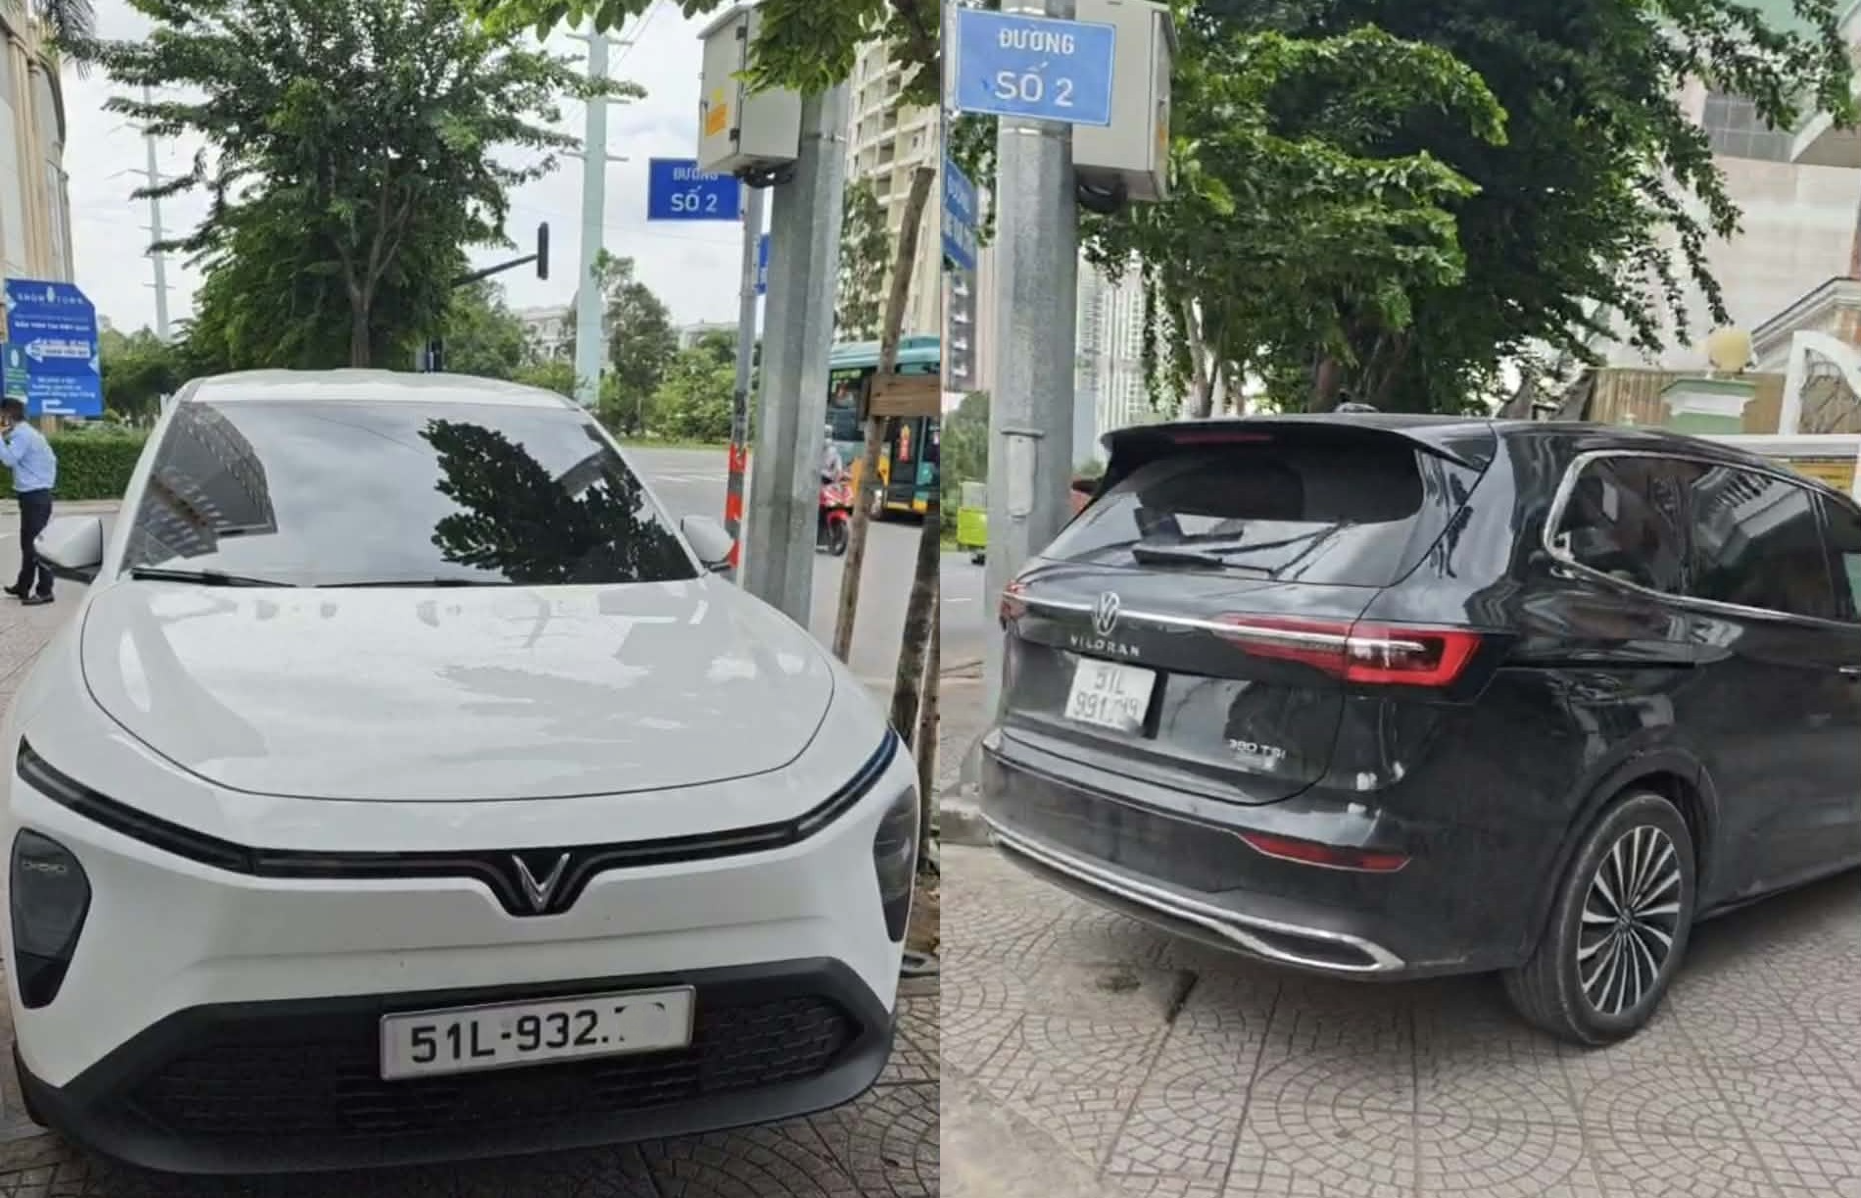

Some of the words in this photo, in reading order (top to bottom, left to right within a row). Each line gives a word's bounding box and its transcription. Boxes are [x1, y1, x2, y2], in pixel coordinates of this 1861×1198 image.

[996, 24, 1075, 55] ĐƯỜNG
[994, 61, 1048, 102] SỐ
[1054, 77, 1073, 107] 2
[671, 185, 702, 212] SỐ
[705, 193, 718, 212] 2
[1070, 633, 1140, 657] VILORAN
